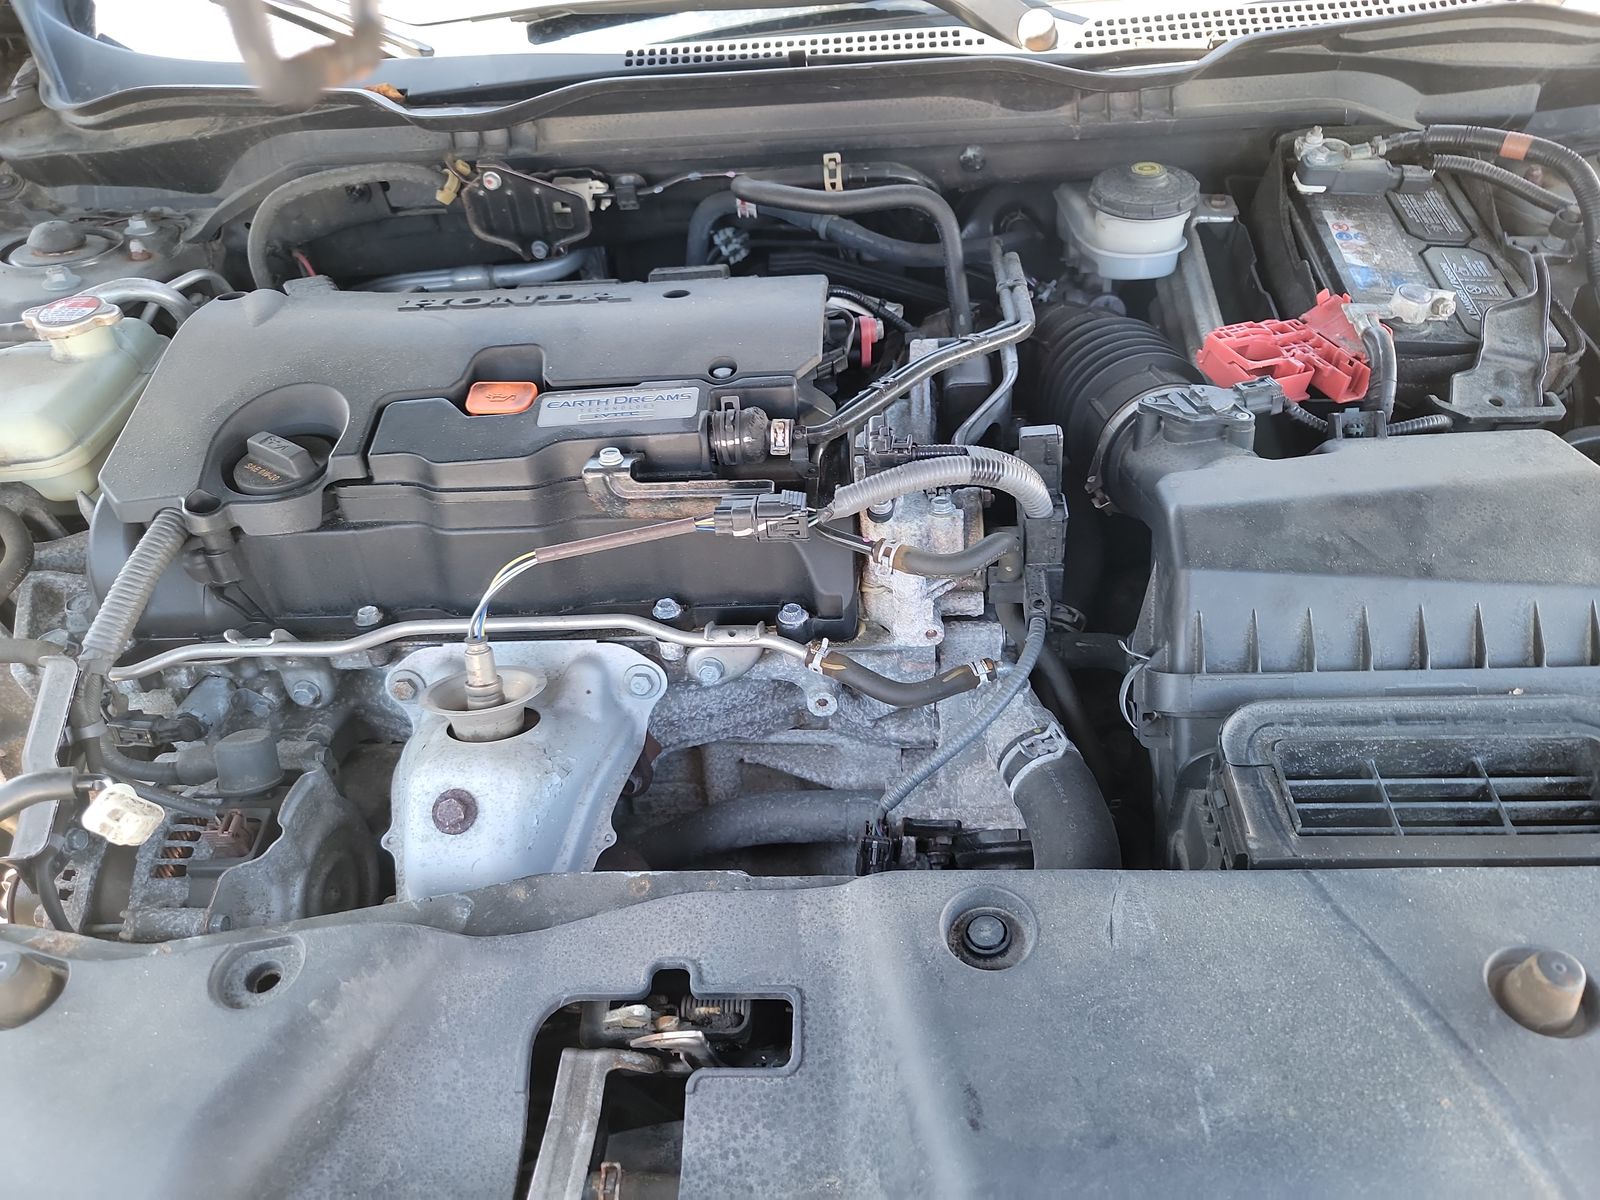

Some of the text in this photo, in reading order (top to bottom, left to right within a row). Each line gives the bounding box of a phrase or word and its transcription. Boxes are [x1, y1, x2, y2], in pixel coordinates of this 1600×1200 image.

[398, 293, 631, 311] HONDA
[547, 392, 692, 409] EARTH DREAMS
[580, 404, 655, 412] TECHNOLOGY
[244, 462, 262, 473] SAE
